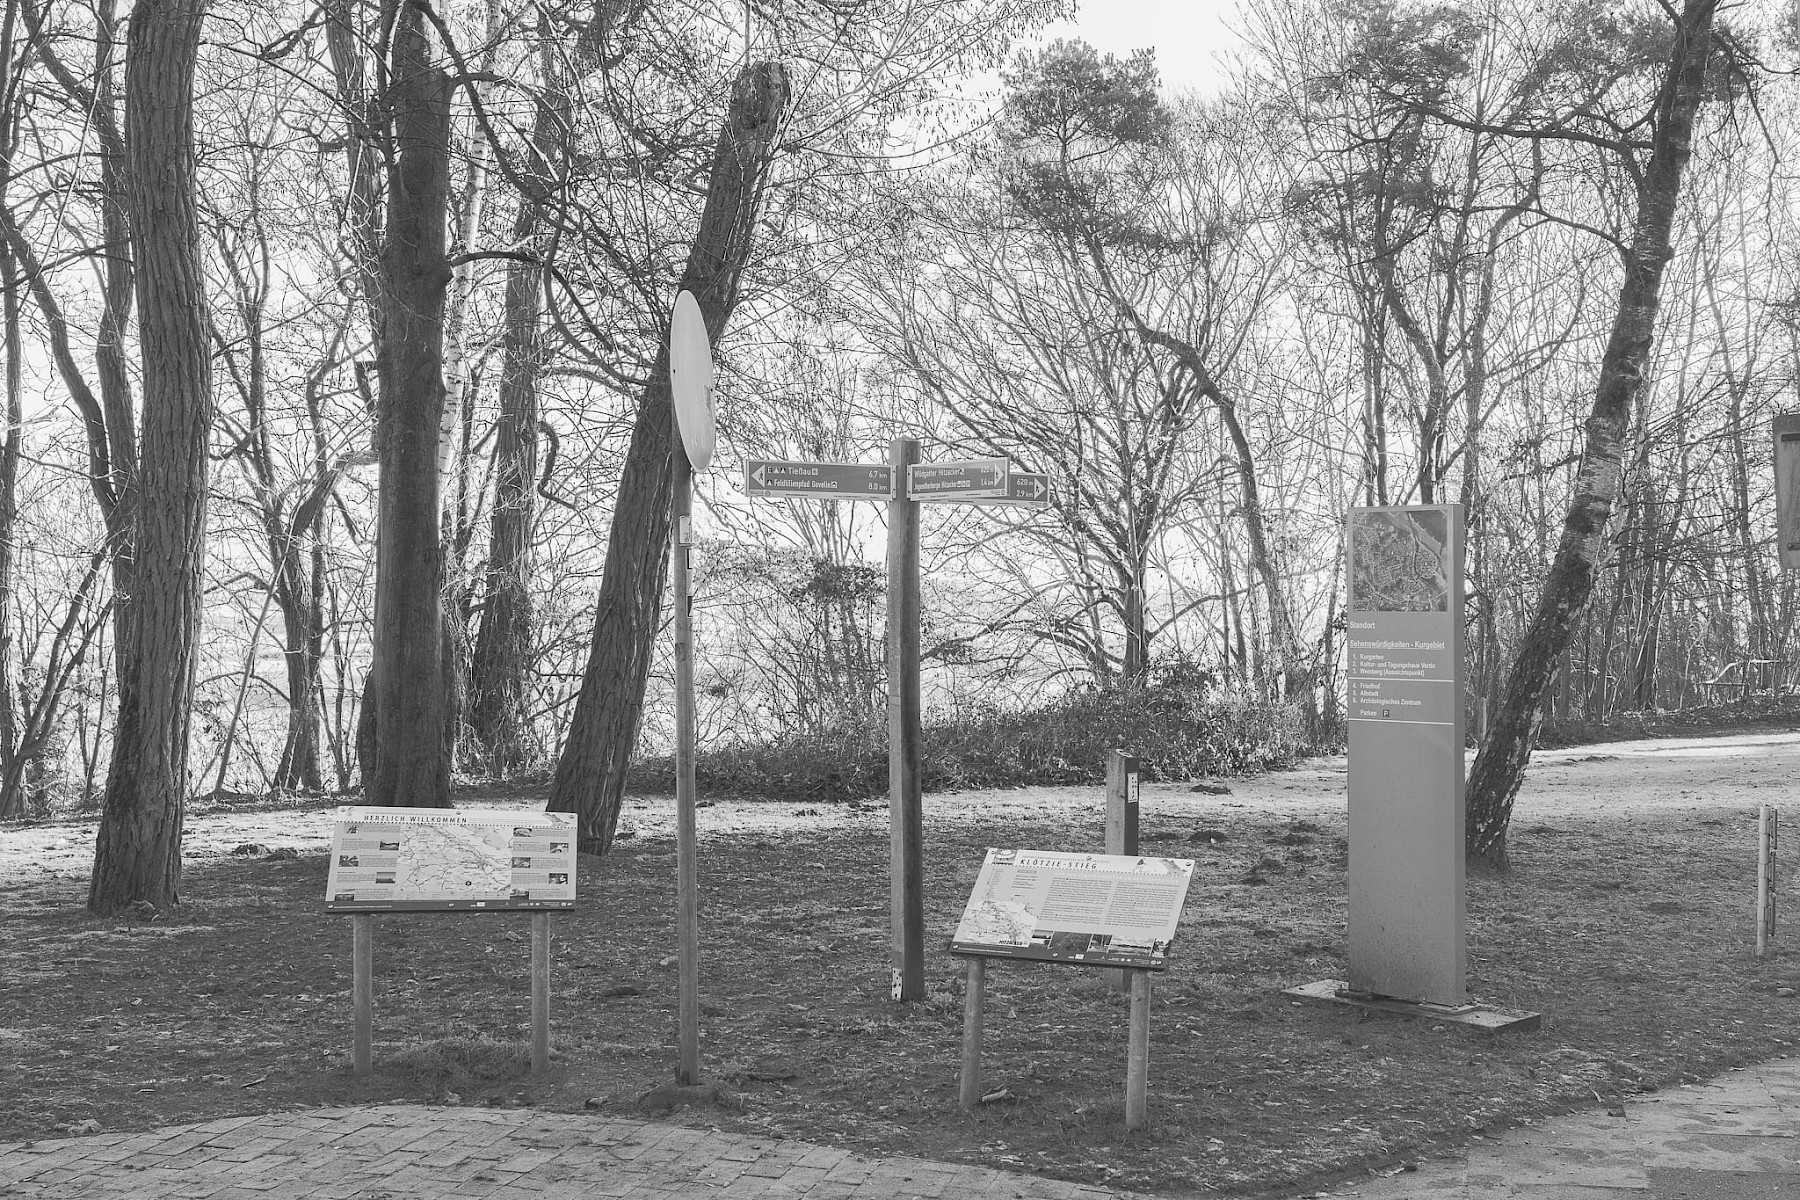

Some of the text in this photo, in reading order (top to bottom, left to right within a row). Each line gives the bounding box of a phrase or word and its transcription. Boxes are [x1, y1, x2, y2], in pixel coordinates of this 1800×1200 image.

[868, 470, 878, 478] 6,7
[1350, 621, 1376, 629] Standort
[1350, 640, 1410, 649] Sehenswürdigkeiten
[1414, 640, 1446, 650] Kurgebiet
[1020, 858, 1097, 869] KLÖTZIE-STIEG
